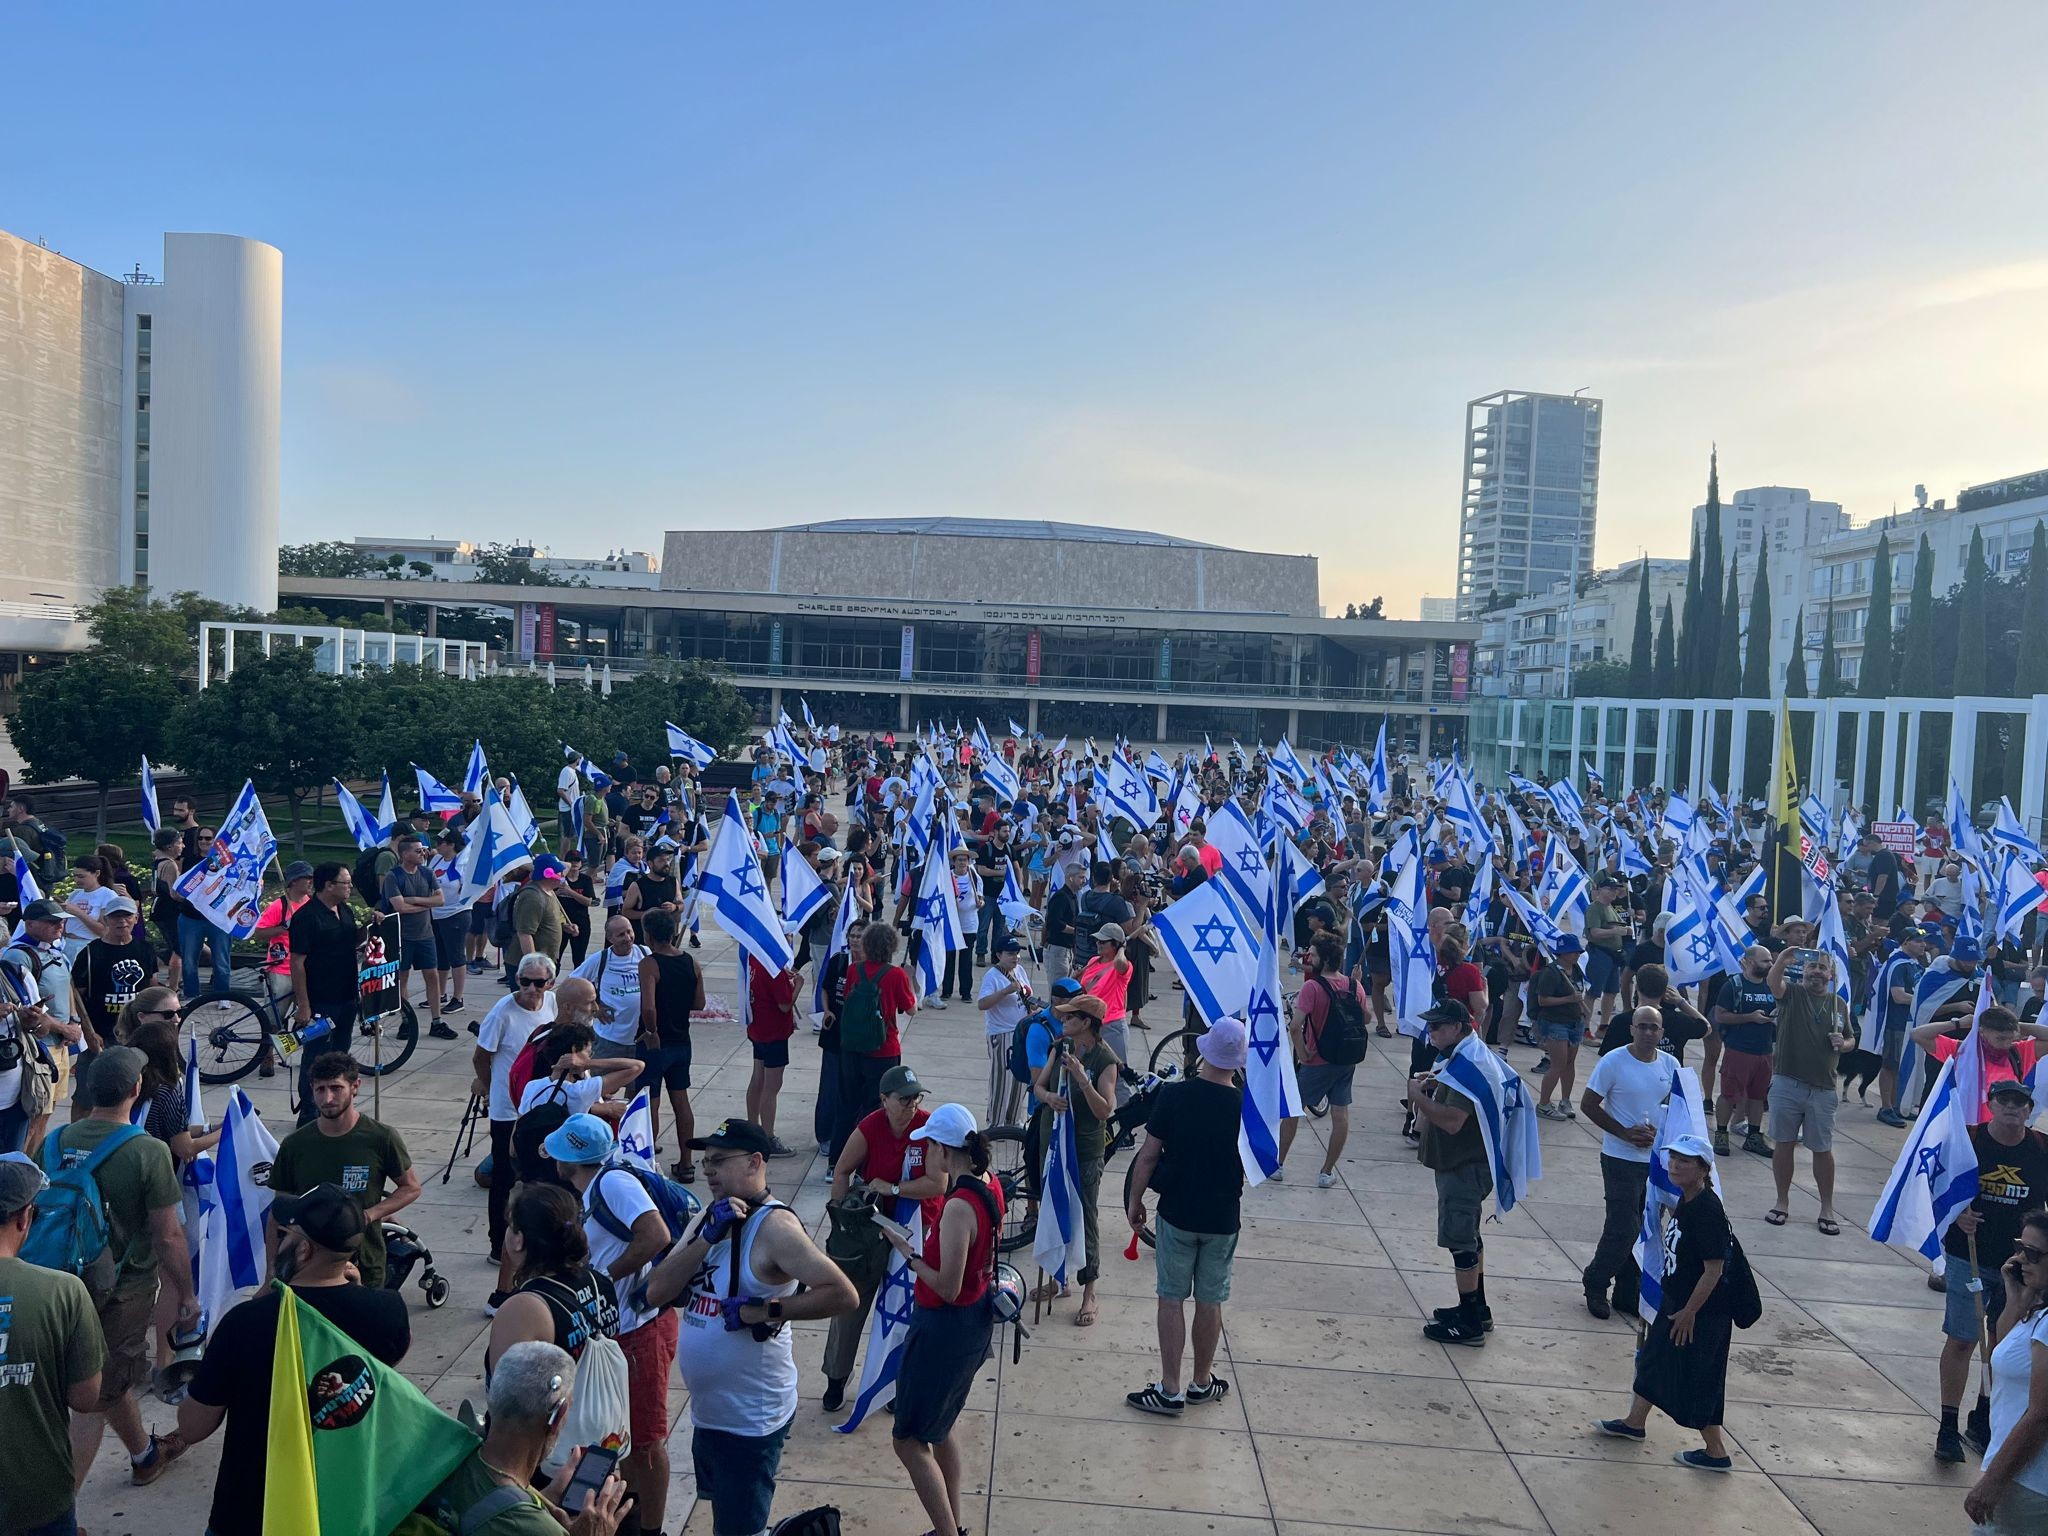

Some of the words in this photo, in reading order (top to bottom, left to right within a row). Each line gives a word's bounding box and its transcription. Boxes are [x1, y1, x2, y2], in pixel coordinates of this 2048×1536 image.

[797, 603, 843, 612] CHARLES
[847, 605, 899, 615] BRONFMAN
[901, 608, 958, 617] AUDITORIUM
[1066, 613, 1101, 622] התרבות
[359, 960, 400, 984] דמוקרטי
[104, 993, 139, 1004] ובה
[2005, 1184, 2030, 1198] כוח
